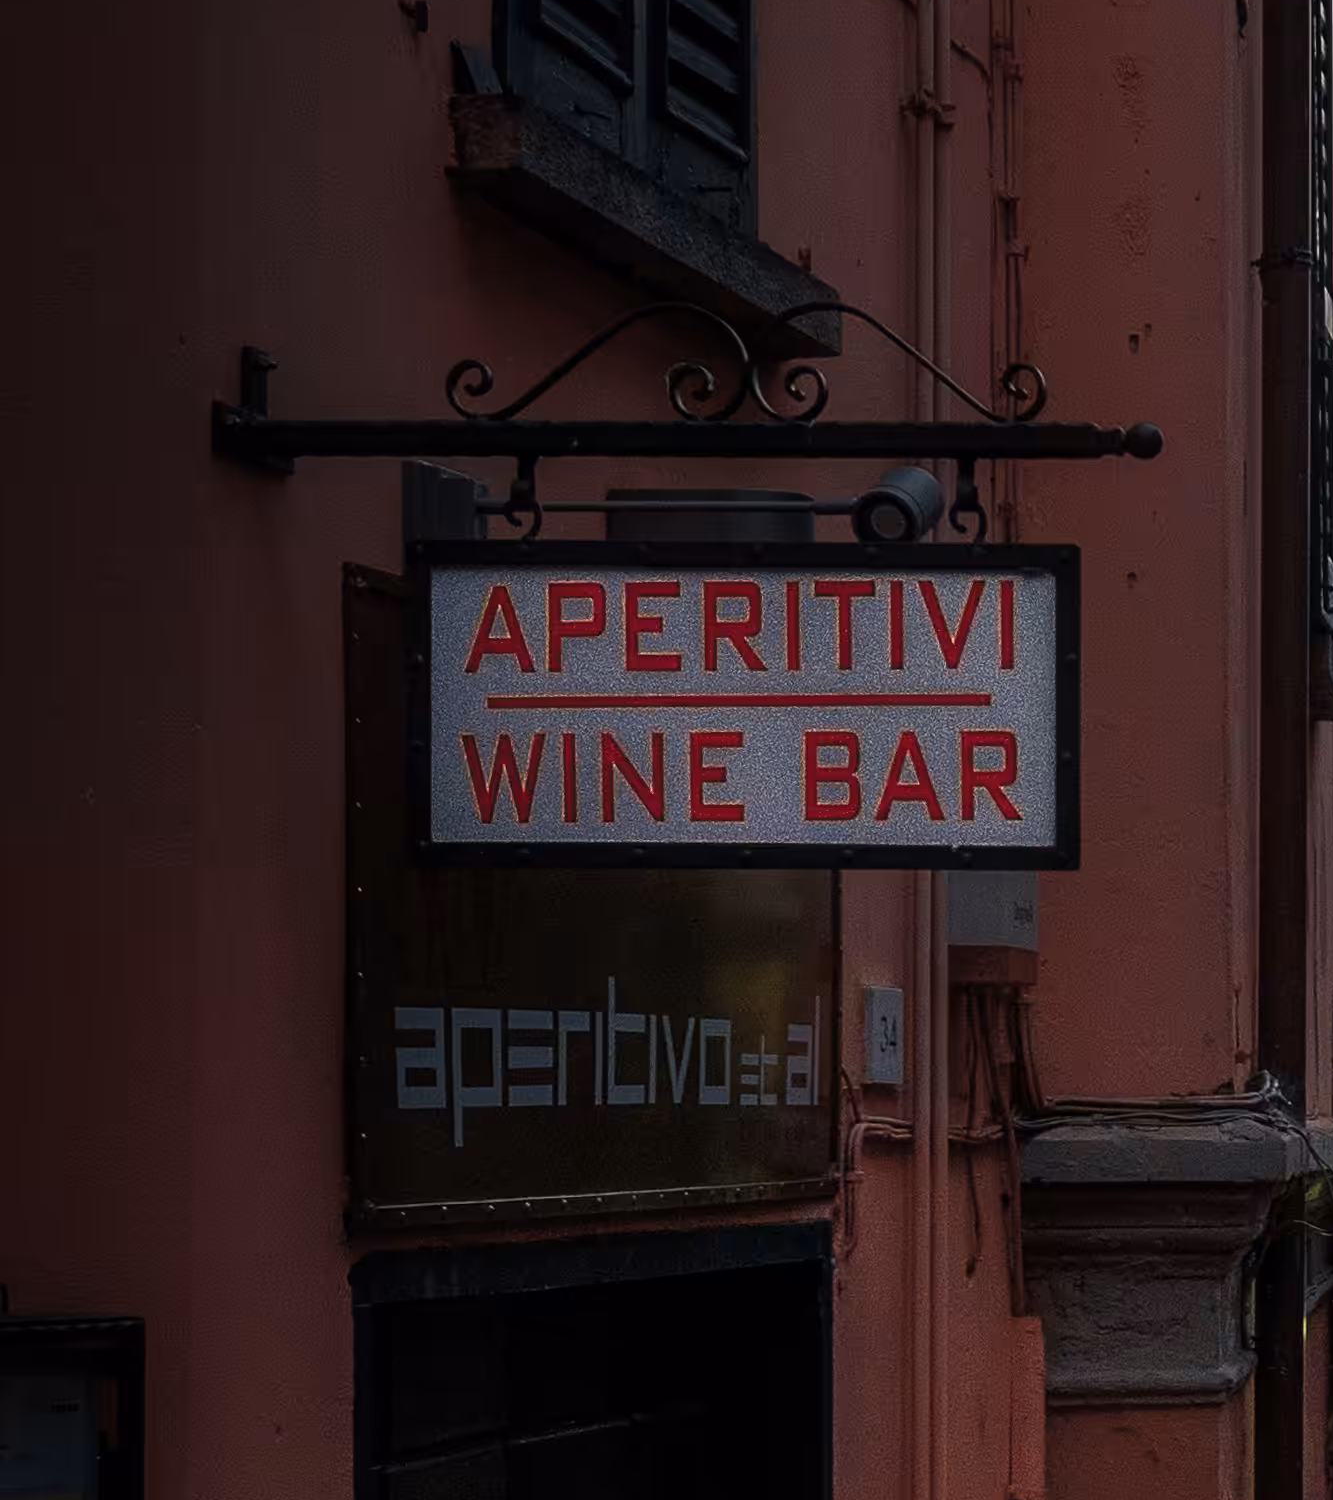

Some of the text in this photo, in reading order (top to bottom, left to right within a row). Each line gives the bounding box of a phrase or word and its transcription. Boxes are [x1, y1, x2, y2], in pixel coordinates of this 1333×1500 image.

[463, 579, 1015, 675] APERITIVI
[461, 729, 1024, 824] WINE BAR
[393, 975, 732, 1148] aperitivo
[881, 1015, 897, 1053] 34
